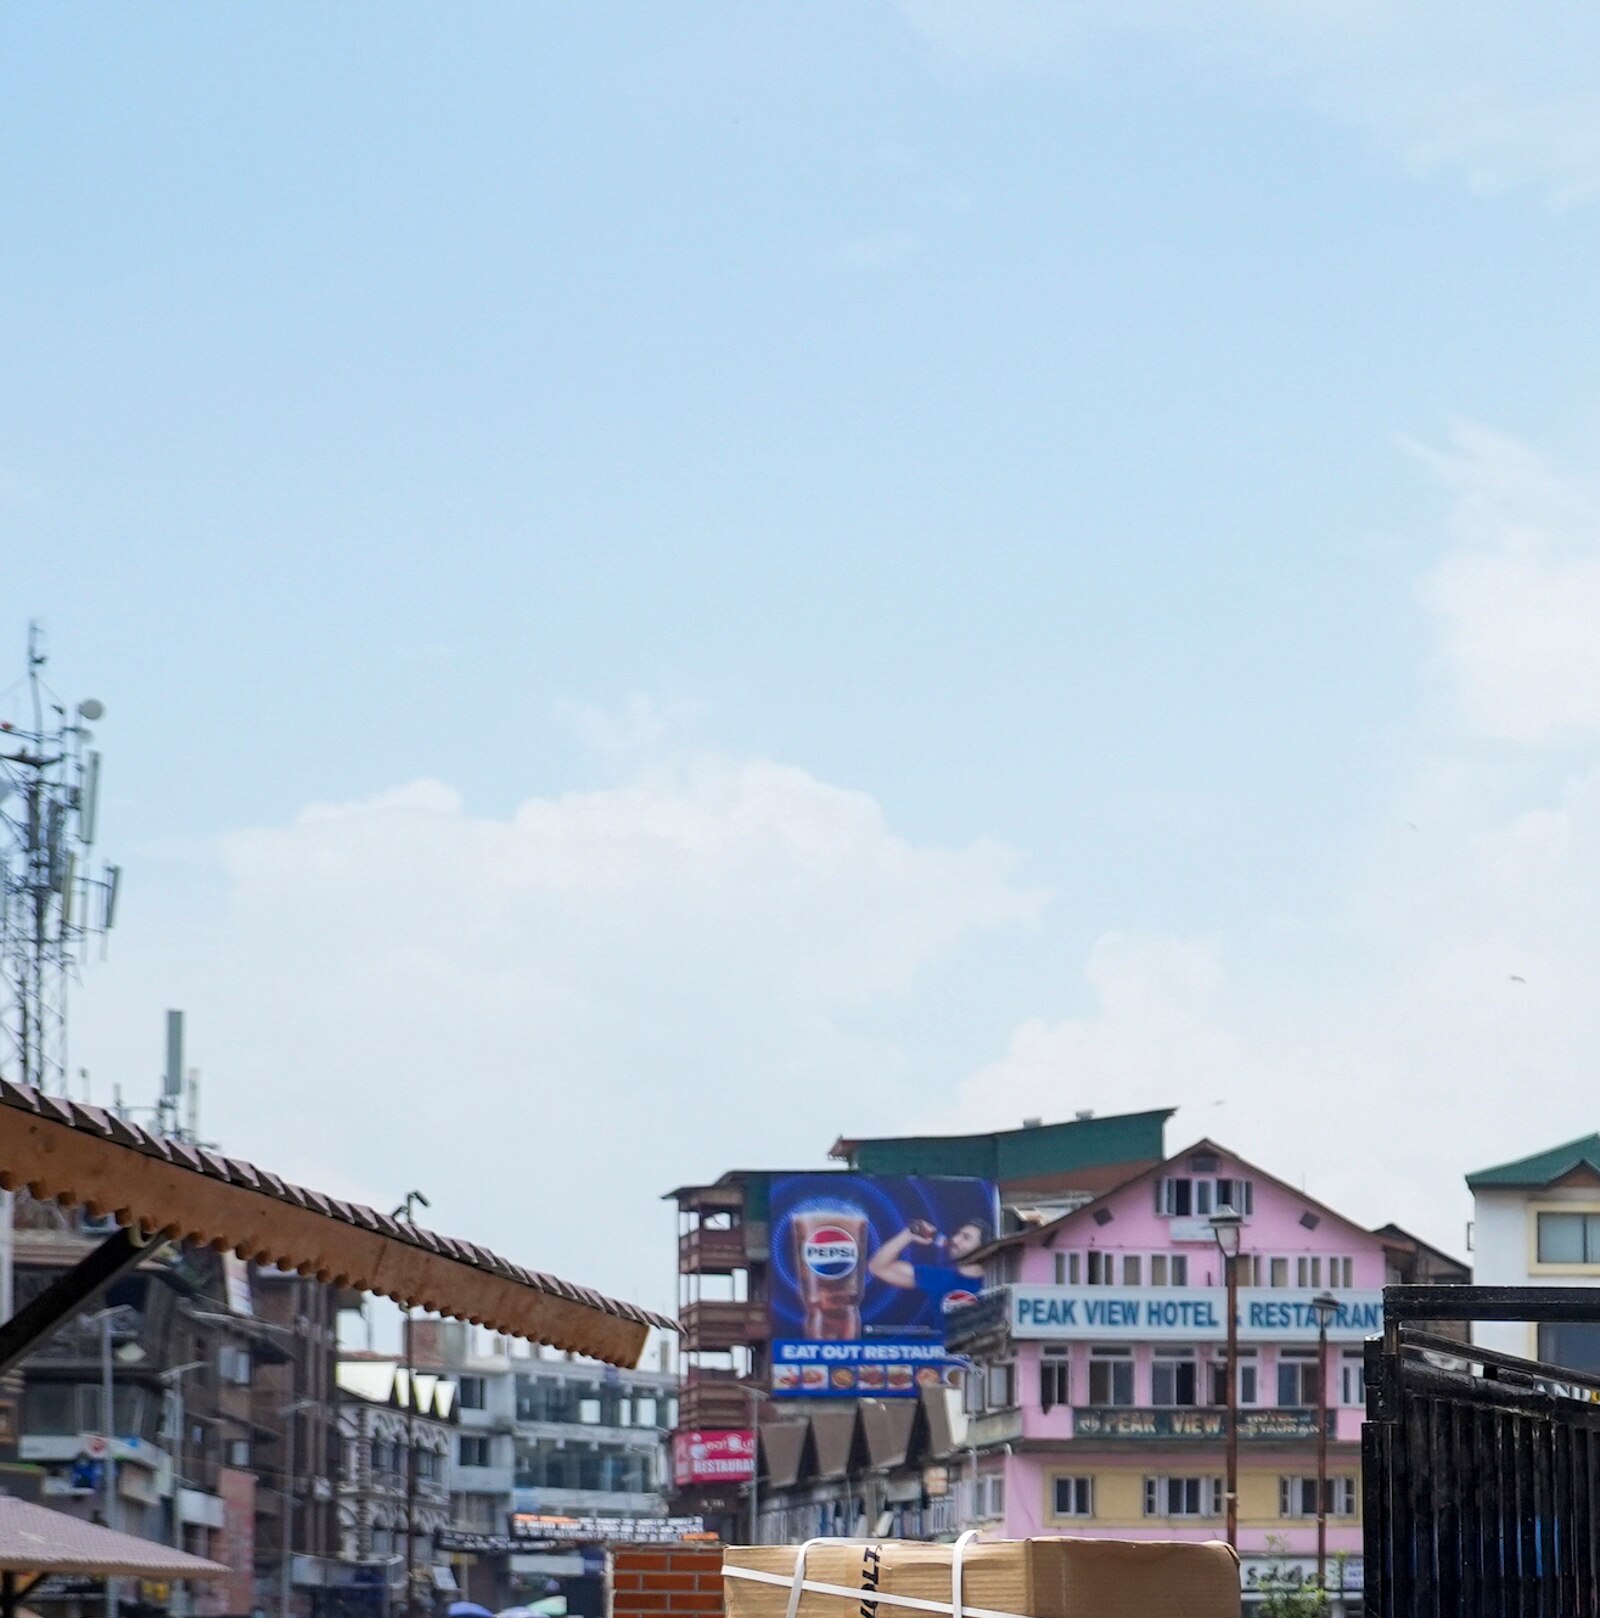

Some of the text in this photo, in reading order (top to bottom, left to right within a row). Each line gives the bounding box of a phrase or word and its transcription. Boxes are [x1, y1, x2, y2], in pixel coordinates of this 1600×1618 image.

[807, 1246, 856, 1259] PEPSI
[1018, 1298, 1077, 1327] PEAK
[1084, 1299, 1139, 1328] VIEW
[1146, 1301, 1219, 1329] HOTEL
[782, 1344, 947, 1361] EAT OUT RESTAUR
[1104, 1412, 1156, 1434] PEAK
[1171, 1413, 1221, 1434] VIEW
